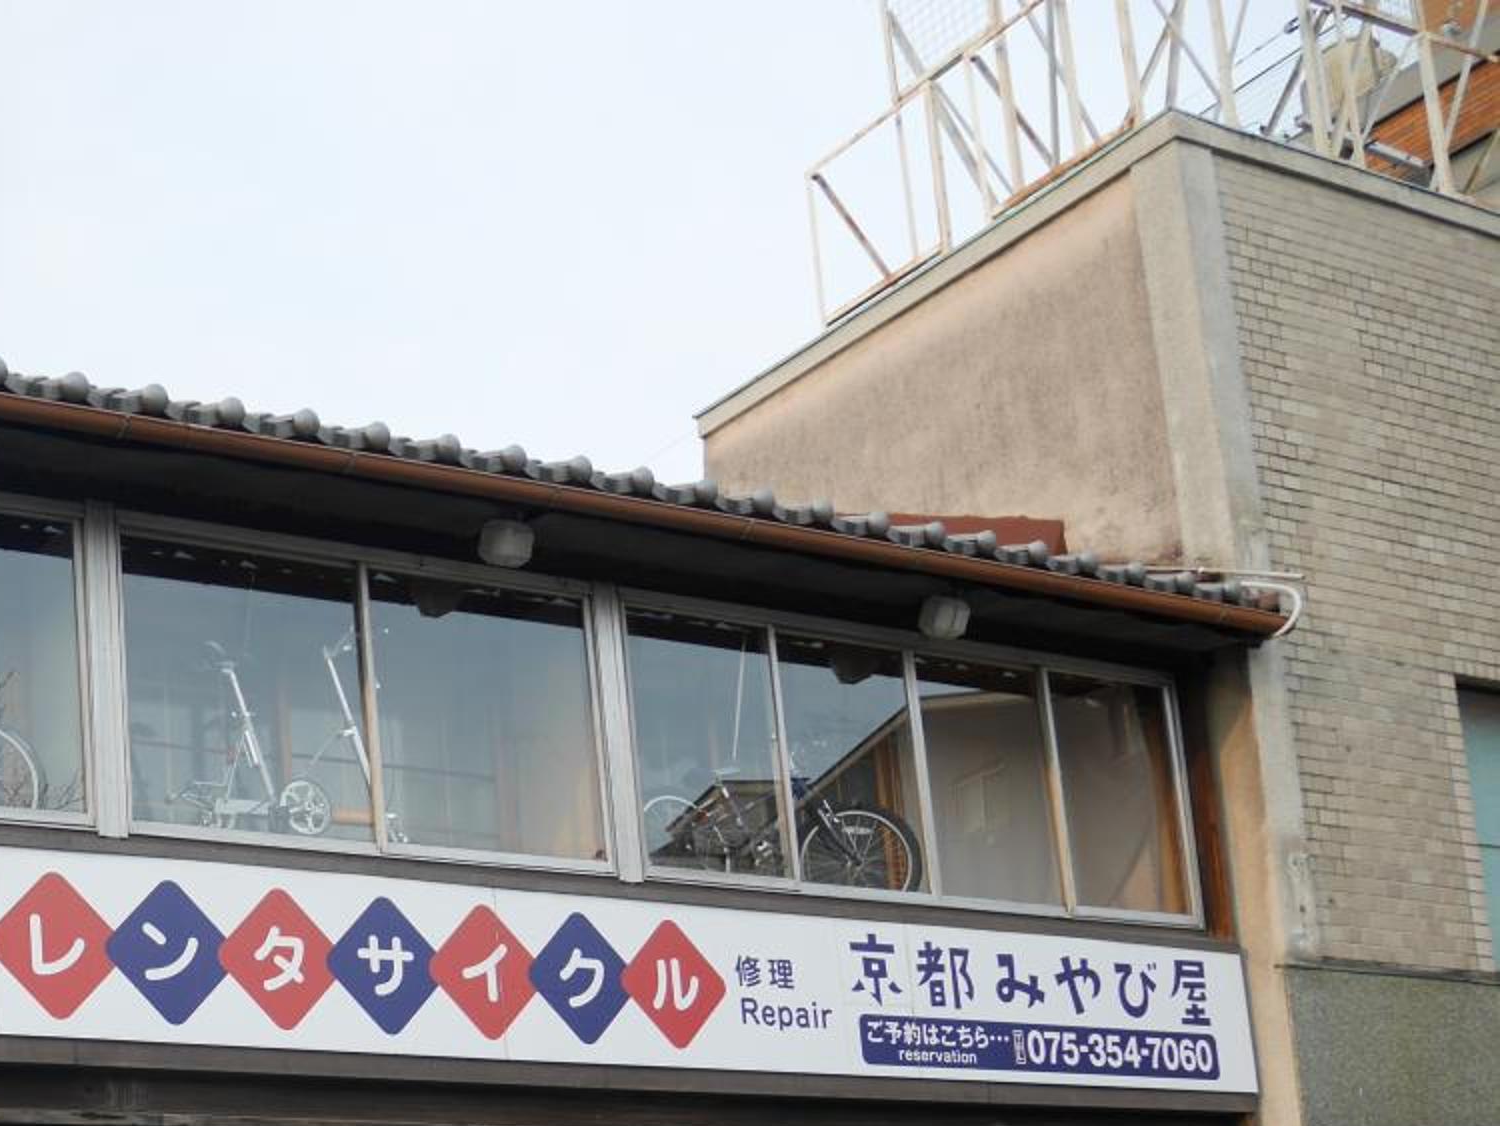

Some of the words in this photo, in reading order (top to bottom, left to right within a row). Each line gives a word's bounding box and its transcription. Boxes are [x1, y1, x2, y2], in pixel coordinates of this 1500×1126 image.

[20, 903, 705, 1018] レンタサイクル
[735, 954, 796, 991] 修理
[848, 932, 1212, 1027] 京都みやび屋
[740, 997, 834, 1032] Repair
[898, 1046, 978, 1066] reservation
[1026, 1029, 1213, 1074] 075-354-7060
